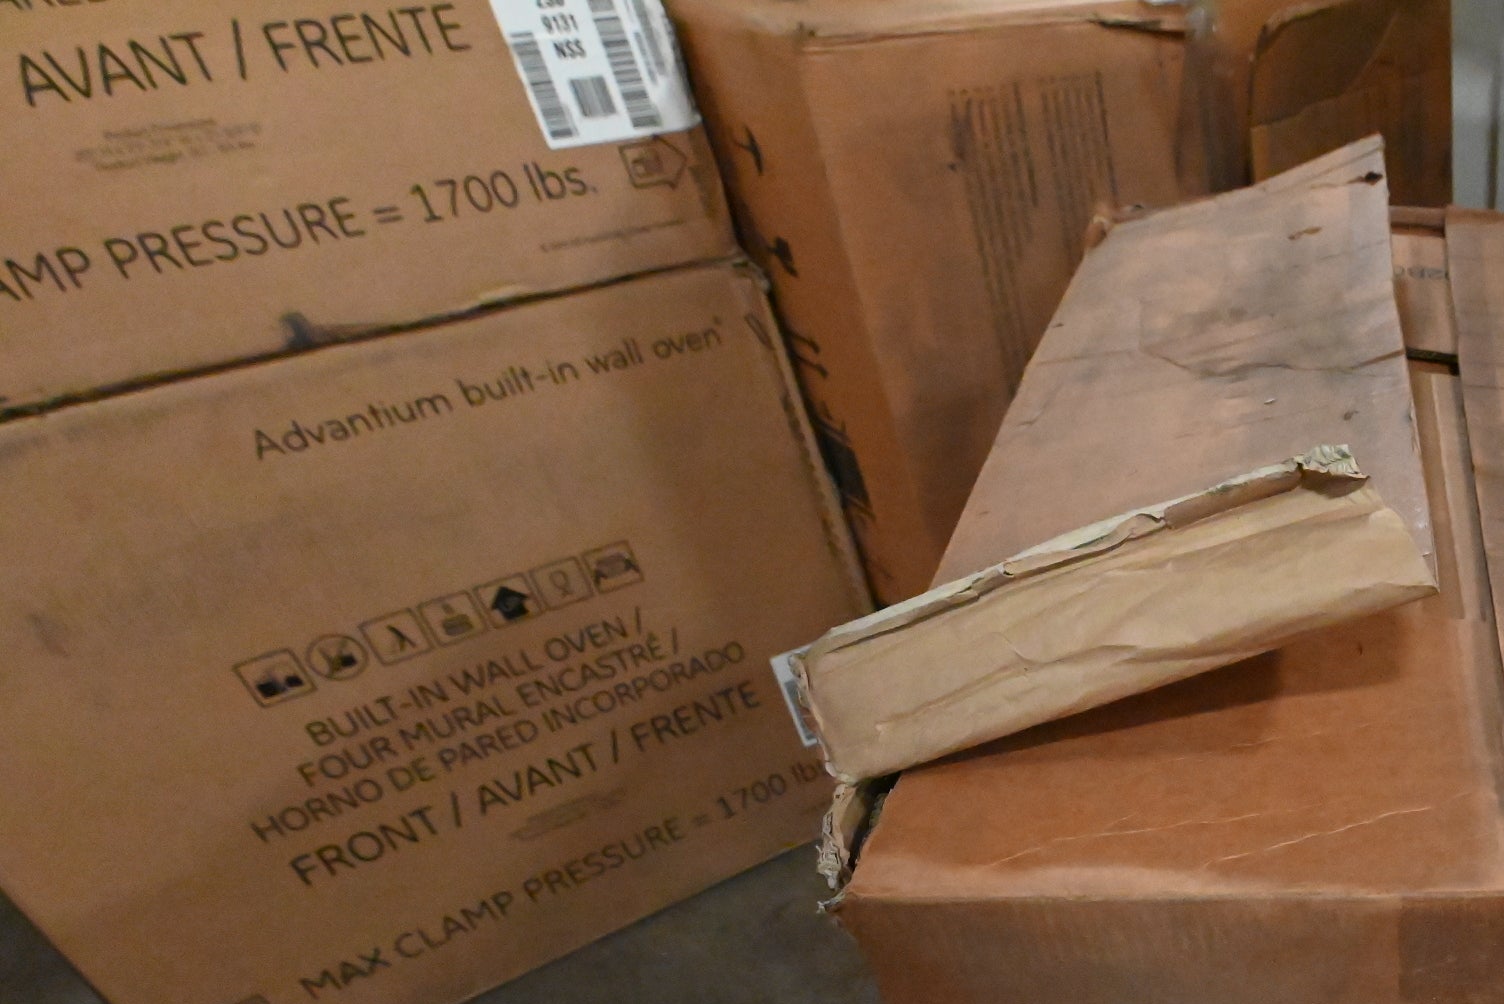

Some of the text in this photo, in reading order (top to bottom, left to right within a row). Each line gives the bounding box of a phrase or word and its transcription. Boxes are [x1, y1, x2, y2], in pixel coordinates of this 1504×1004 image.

[19, 2, 472, 108] AVANT / FRENTE
[103, 196, 365, 280] PRESSURE
[373, 205, 403, 224] =
[409, 170, 518, 223] 1700
[523, 161, 598, 202] lbs.
[253, 393, 454, 461] Advantium
[454, 360, 580, 408] built-in
[584, 337, 645, 375] wall
[250, 640, 747, 844] HORNO DE PARED INCORPORADO
[296, 735, 399, 788] FOUR
[397, 696, 519, 751] MURAL
[515, 631, 667, 709] ENCASTRÉ
[304, 680, 450, 747] BUILT-IN
[449, 651, 544, 696] WALL
[544, 615, 629, 662] OVEN
[288, 804, 438, 886] FRONT
[450, 790, 462, 828] /
[478, 741, 599, 815] AVANT
[610, 727, 620, 765] /
[630, 679, 763, 753] FRENTE
[299, 947, 391, 1000] MAX
[393, 890, 515, 959] CLAMP
[522, 815, 686, 901] PRESSURE
[715, 773, 788, 820] 1700
